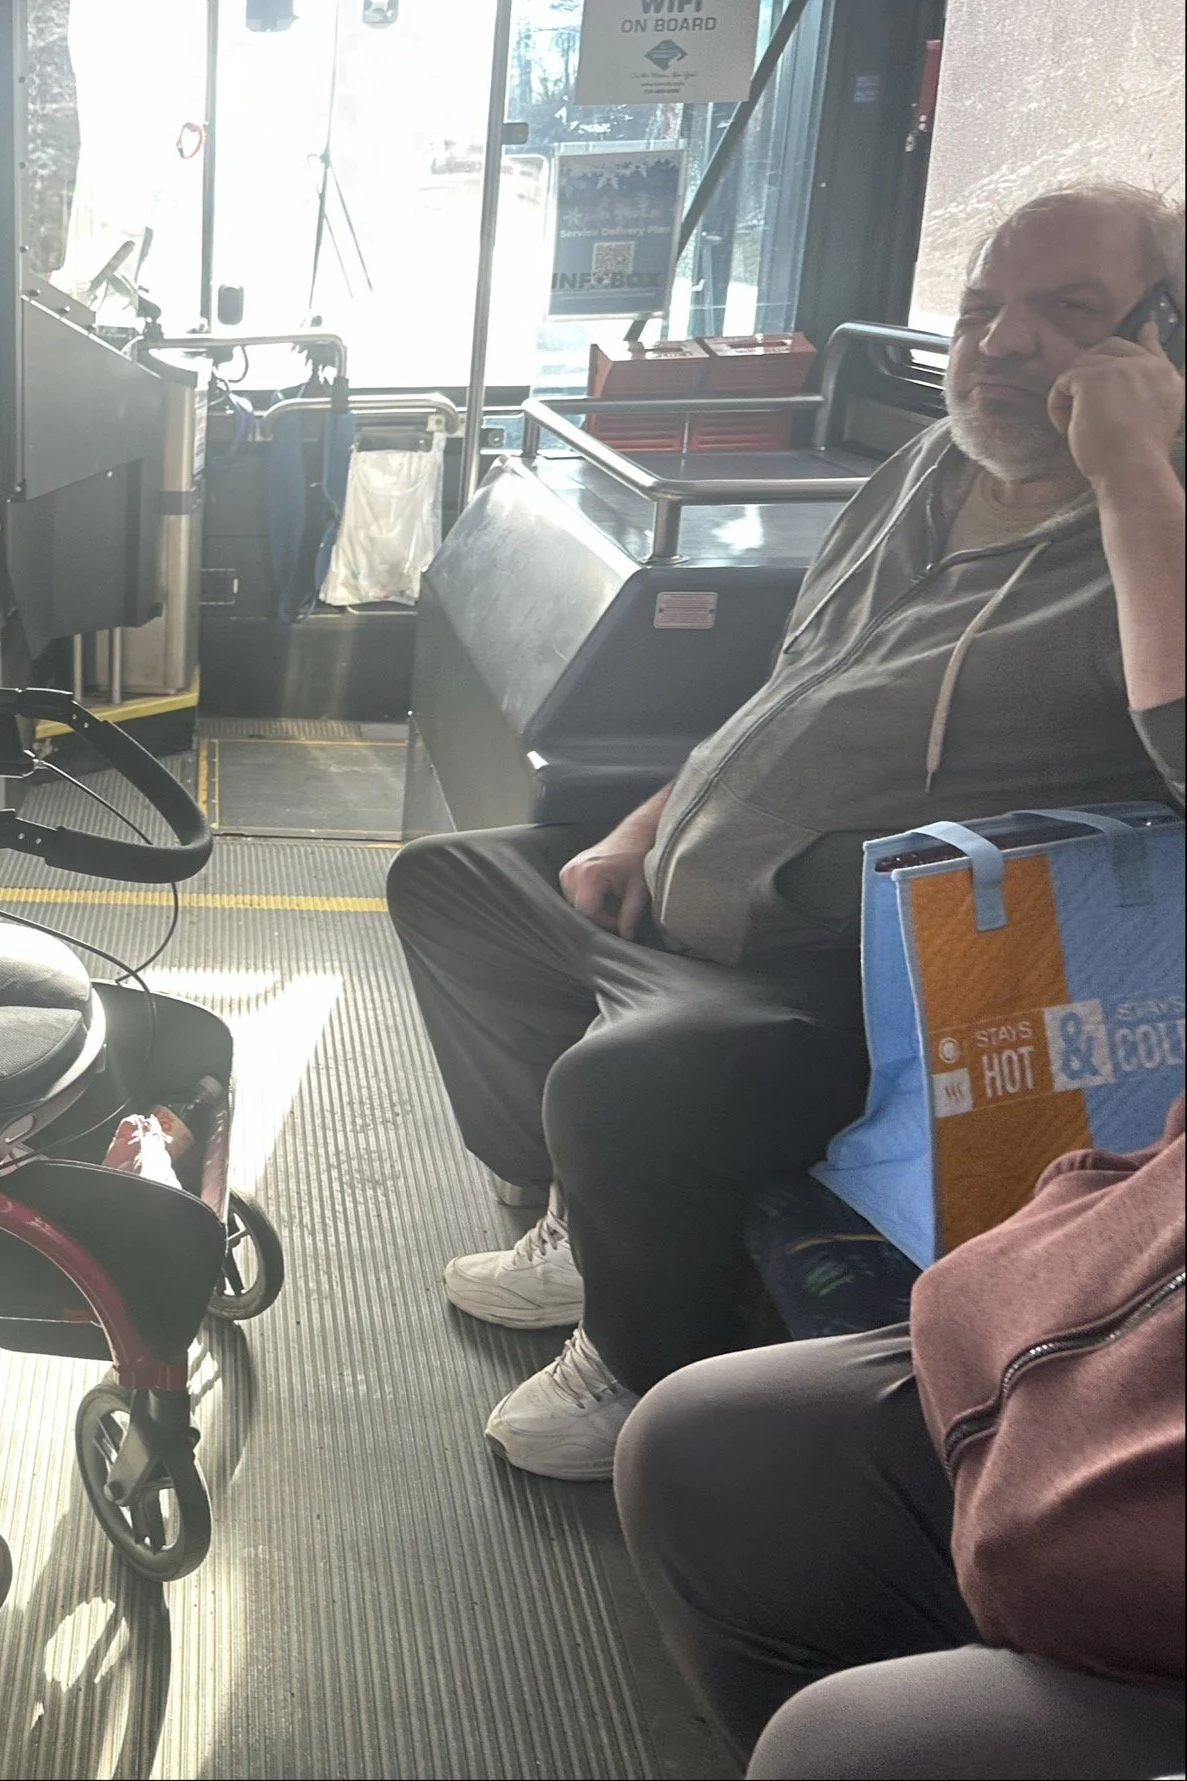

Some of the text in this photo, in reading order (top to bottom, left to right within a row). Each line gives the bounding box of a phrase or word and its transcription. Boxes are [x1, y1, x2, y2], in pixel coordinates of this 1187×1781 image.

[621, 17, 717, 33] ON BOARD
[560, 229, 599, 238] Service
[601, 227, 646, 238] Delivery
[1116, 995, 1185, 1021] STAYS
[976, 1021, 1032, 1048] STAYS
[1059, 1011, 1102, 1081] &
[982, 1046, 1035, 1098] HOT
